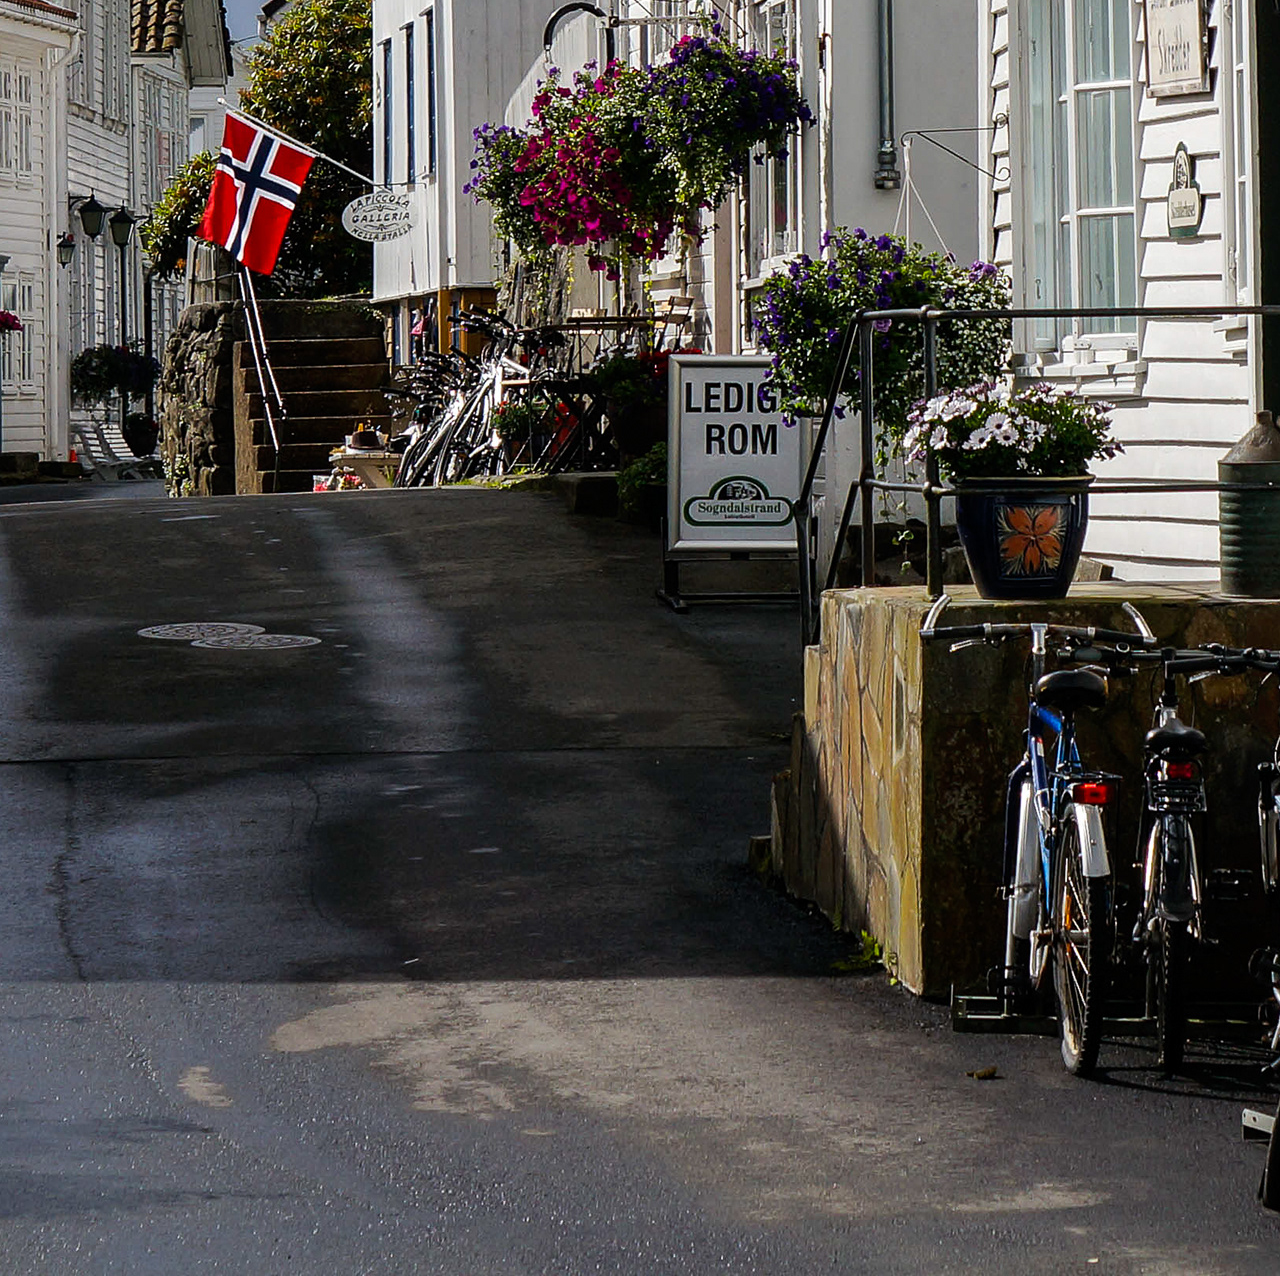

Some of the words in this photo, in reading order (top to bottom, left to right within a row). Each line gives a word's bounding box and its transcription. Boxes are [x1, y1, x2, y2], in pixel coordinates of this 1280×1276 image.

[351, 212, 410, 224] GALLERIA
[685, 382, 784, 414] LEDIG
[705, 423, 777, 455] ROM
[698, 502, 781, 517] Sogndalstrand
